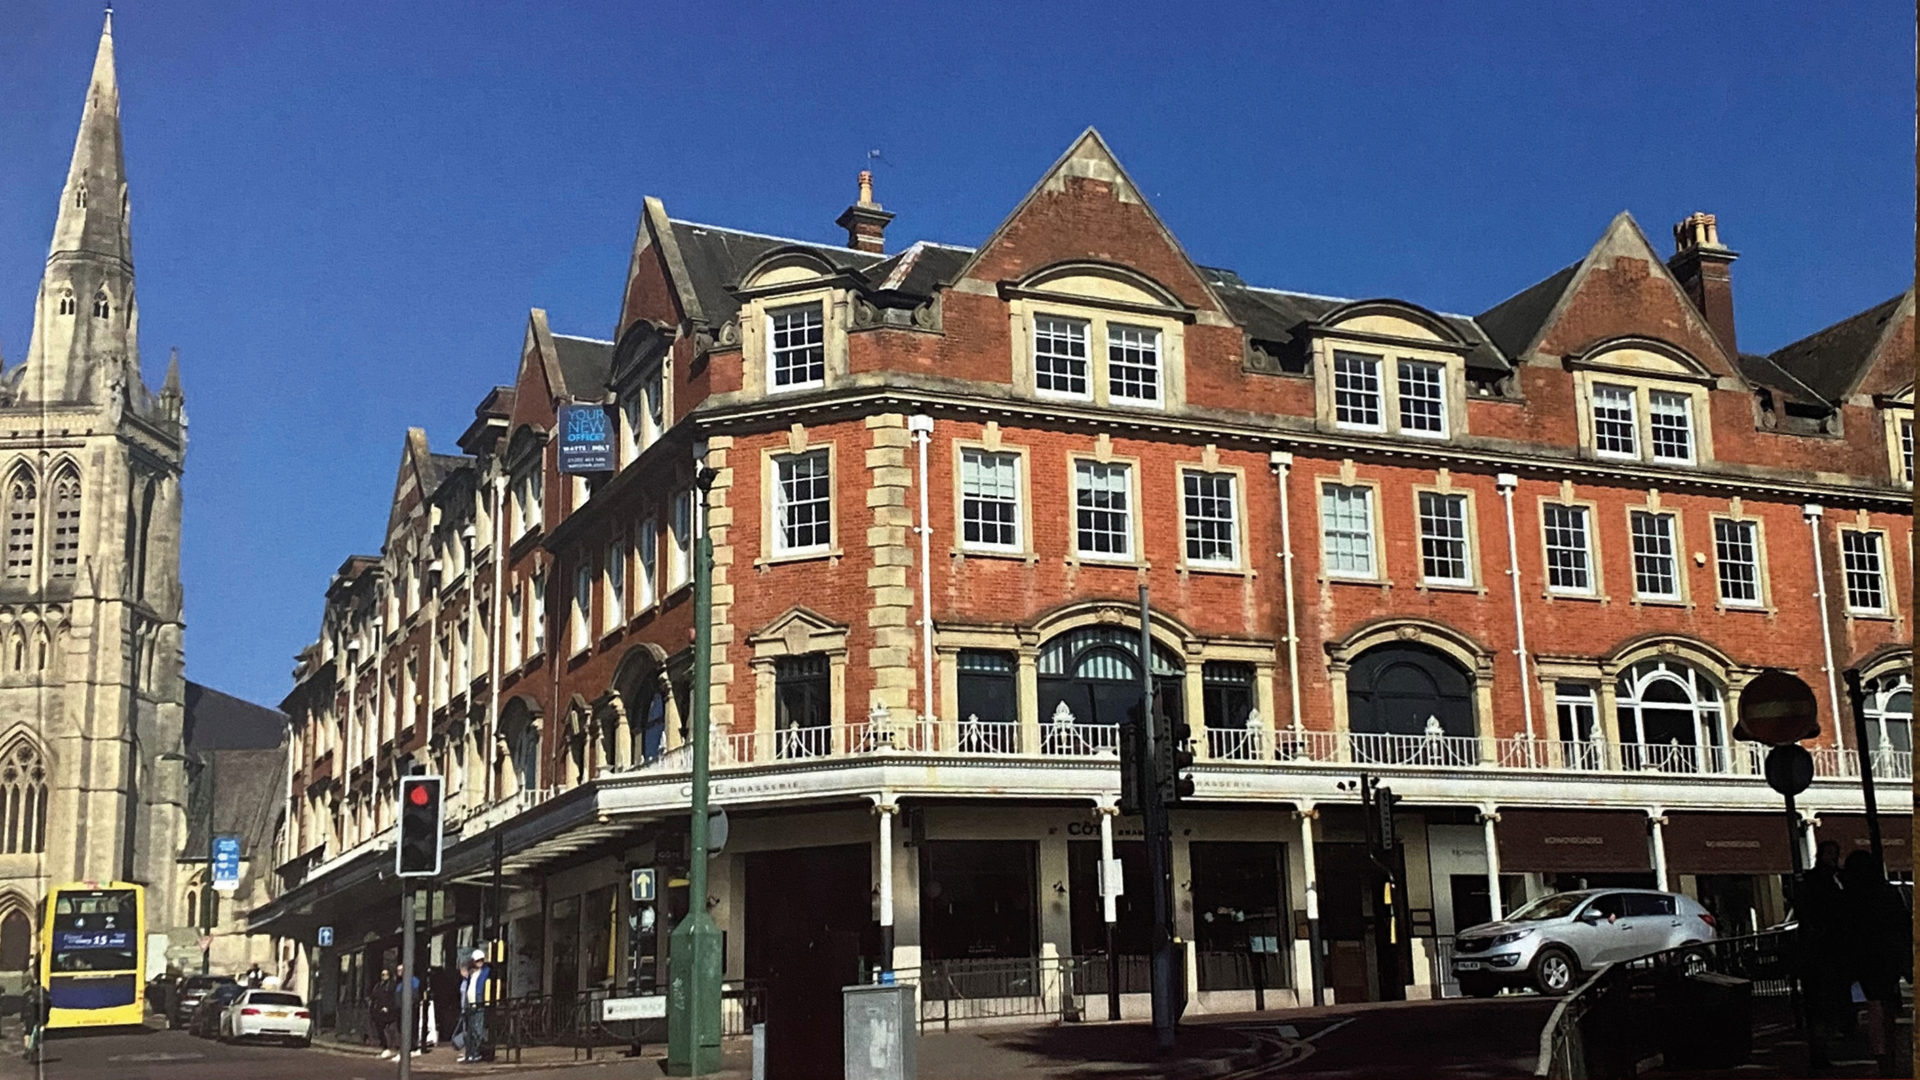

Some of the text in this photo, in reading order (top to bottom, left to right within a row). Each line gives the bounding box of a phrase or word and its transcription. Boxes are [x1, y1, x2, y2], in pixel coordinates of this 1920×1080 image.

[568, 409, 604, 420] YOUR
[568, 420, 605, 432] NEW
[680, 781, 799, 798] CTE BRASSERIE
[1067, 821, 1102, 836] CÔT
[93, 935, 108, 945] 15
